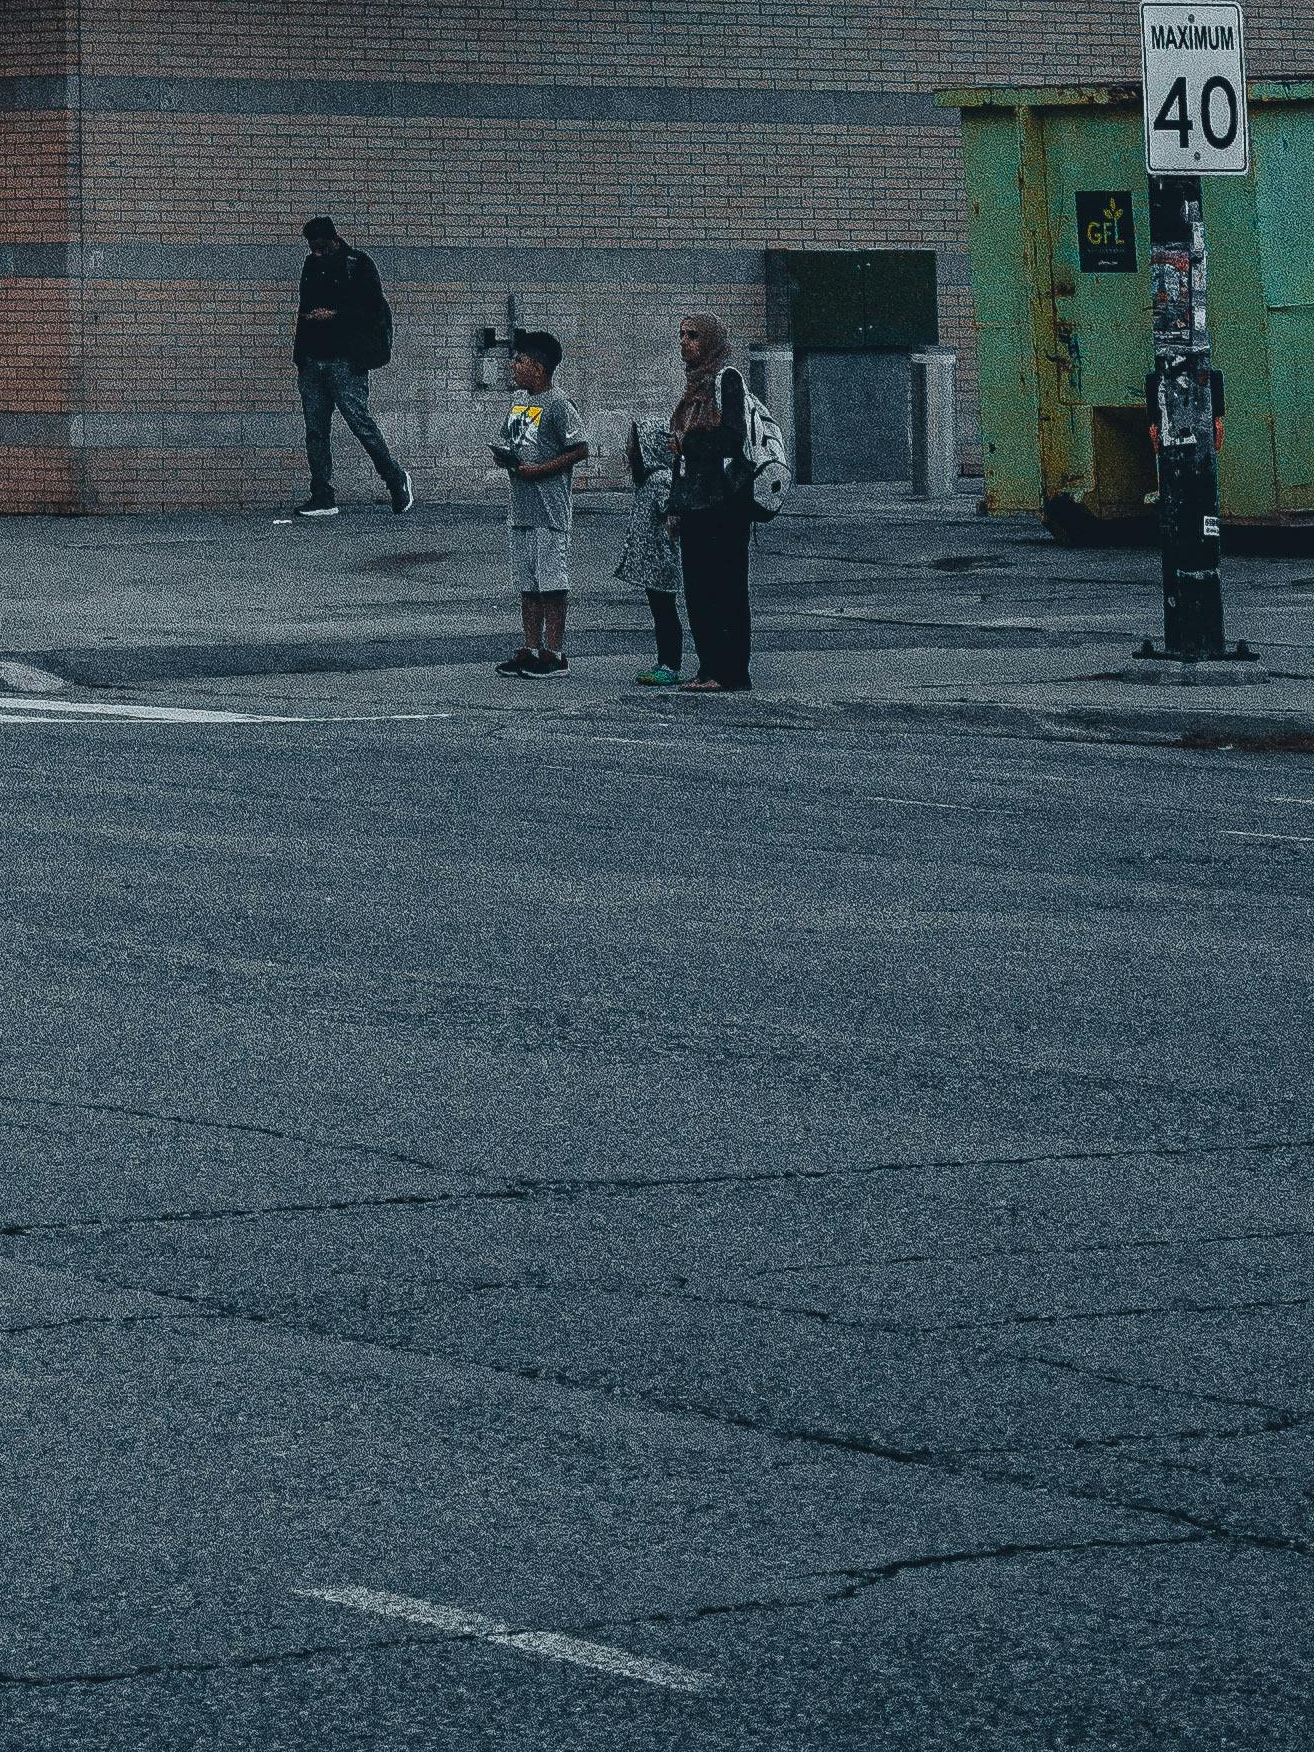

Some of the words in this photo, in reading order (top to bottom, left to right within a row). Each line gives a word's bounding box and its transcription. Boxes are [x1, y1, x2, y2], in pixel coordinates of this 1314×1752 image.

[1151, 25, 1234, 50] MAXIMUM
[1153, 75, 1238, 150] 40
[1086, 217, 1126, 245] GFL
